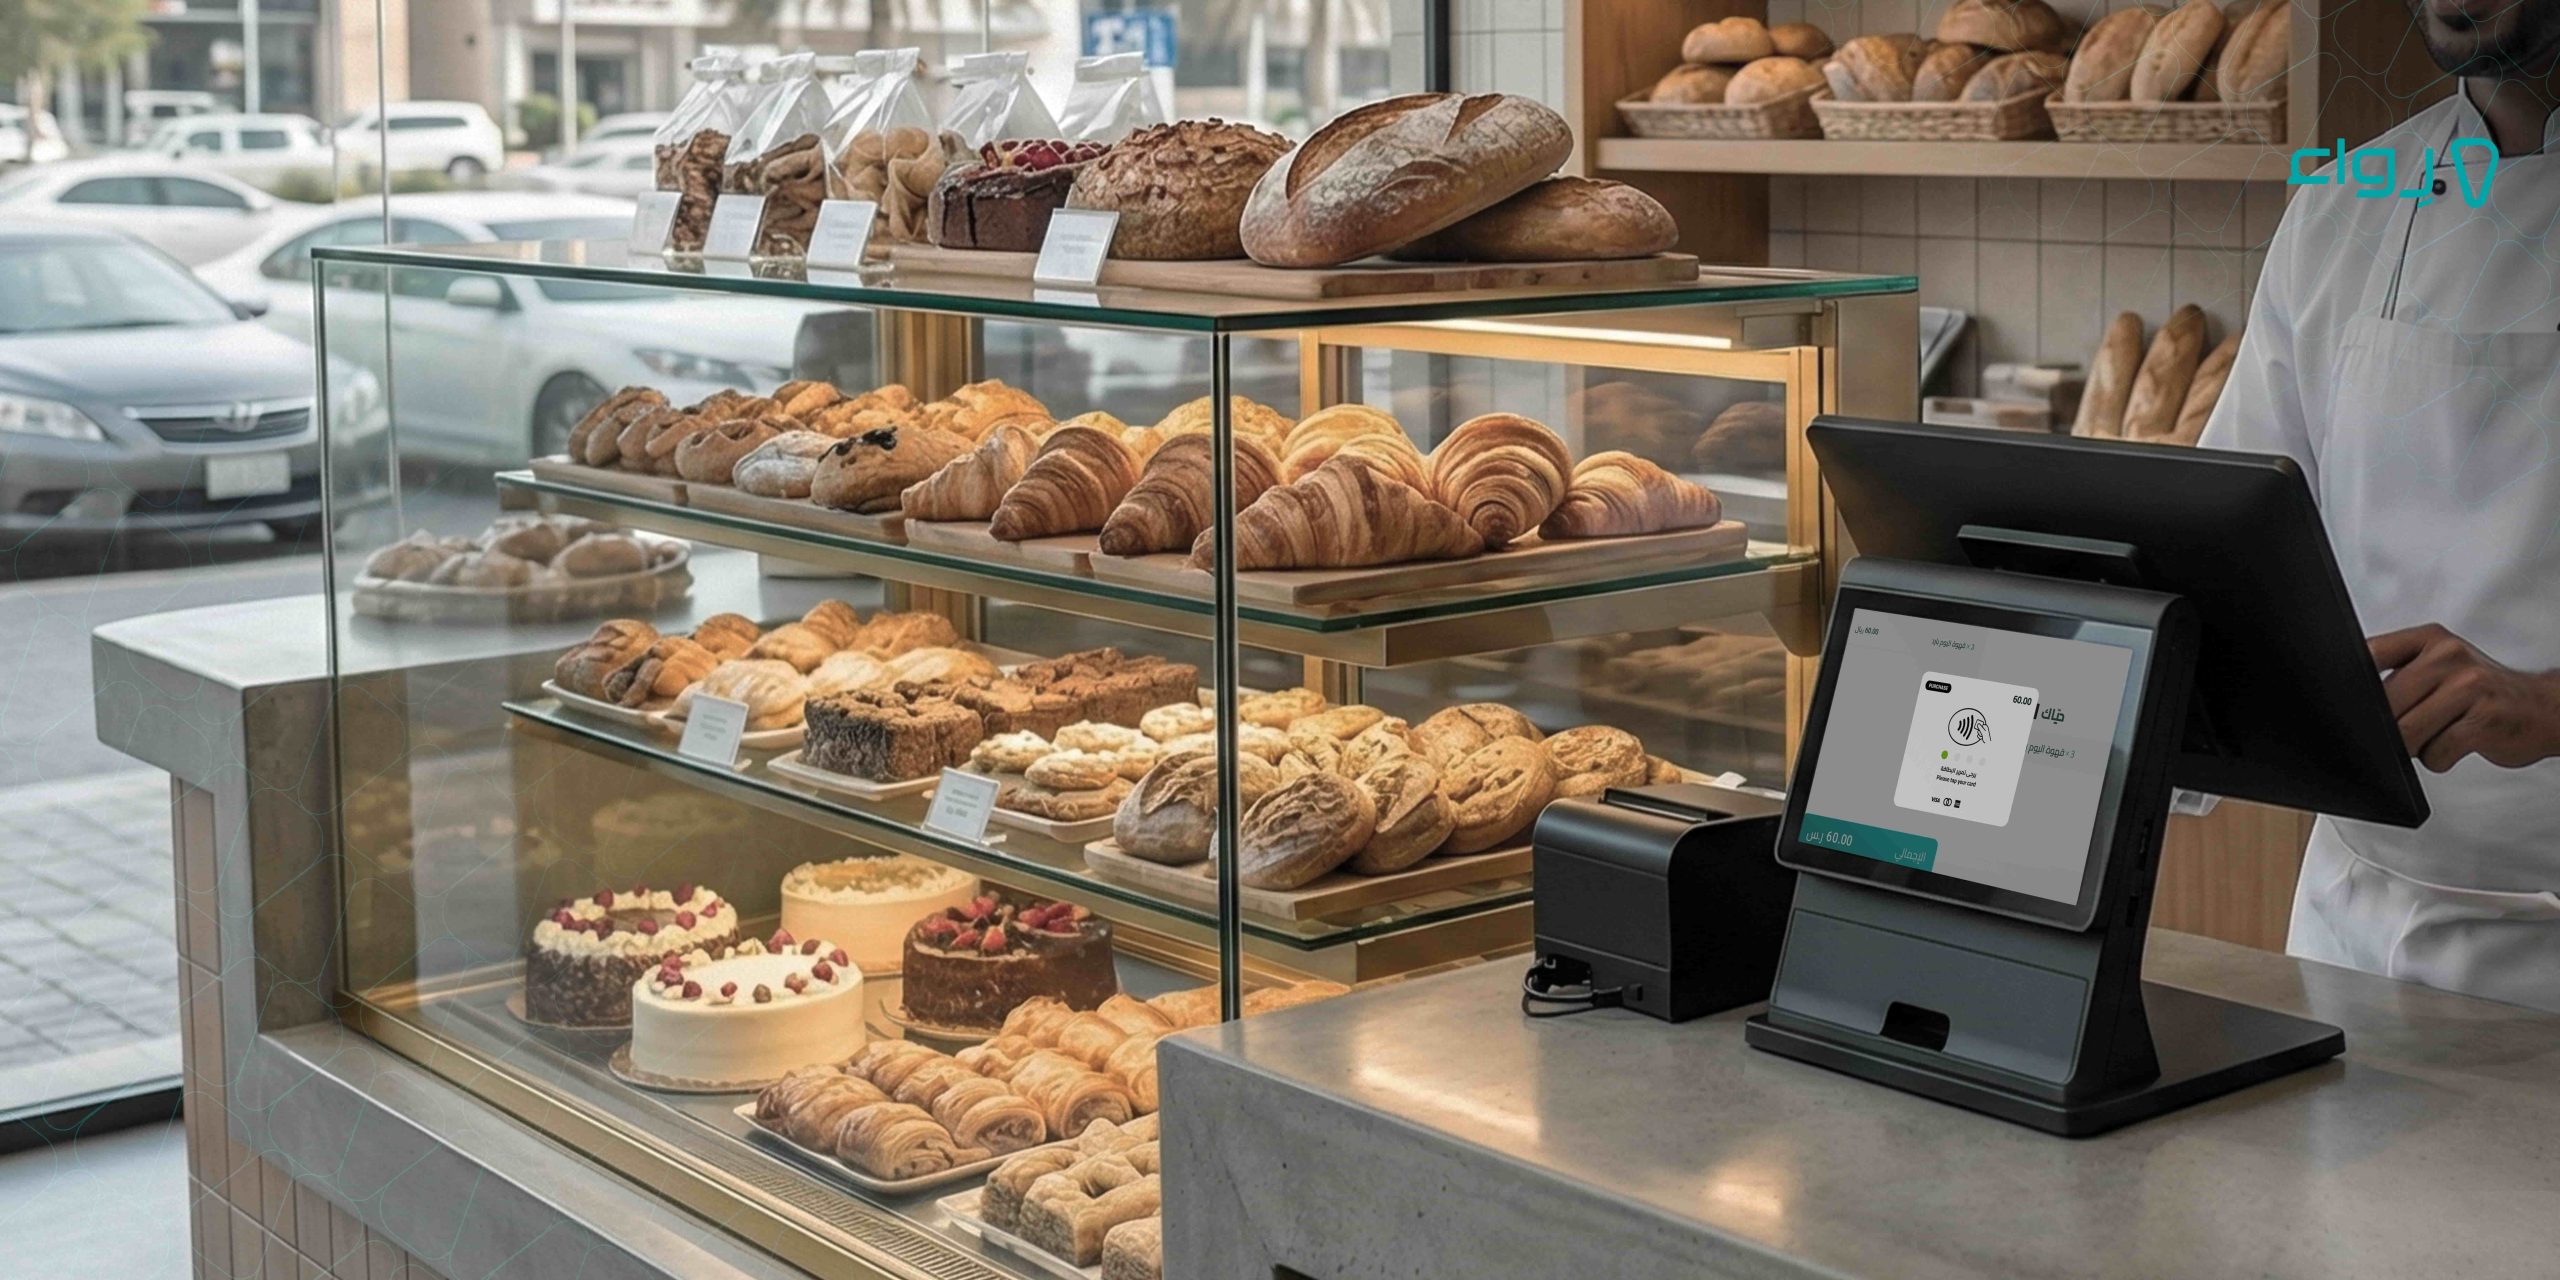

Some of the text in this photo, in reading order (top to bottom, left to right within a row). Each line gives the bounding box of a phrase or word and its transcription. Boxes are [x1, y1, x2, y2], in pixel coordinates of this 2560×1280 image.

[1929, 683, 1948, 691] PURCHASE
[2012, 695, 2032, 706] 60.00
[2028, 744, 2045, 755] اليوم
[2045, 746, 2065, 758] قهوة
[1936, 774, 1949, 782] Please
[1826, 831, 1853, 847] 60.00
